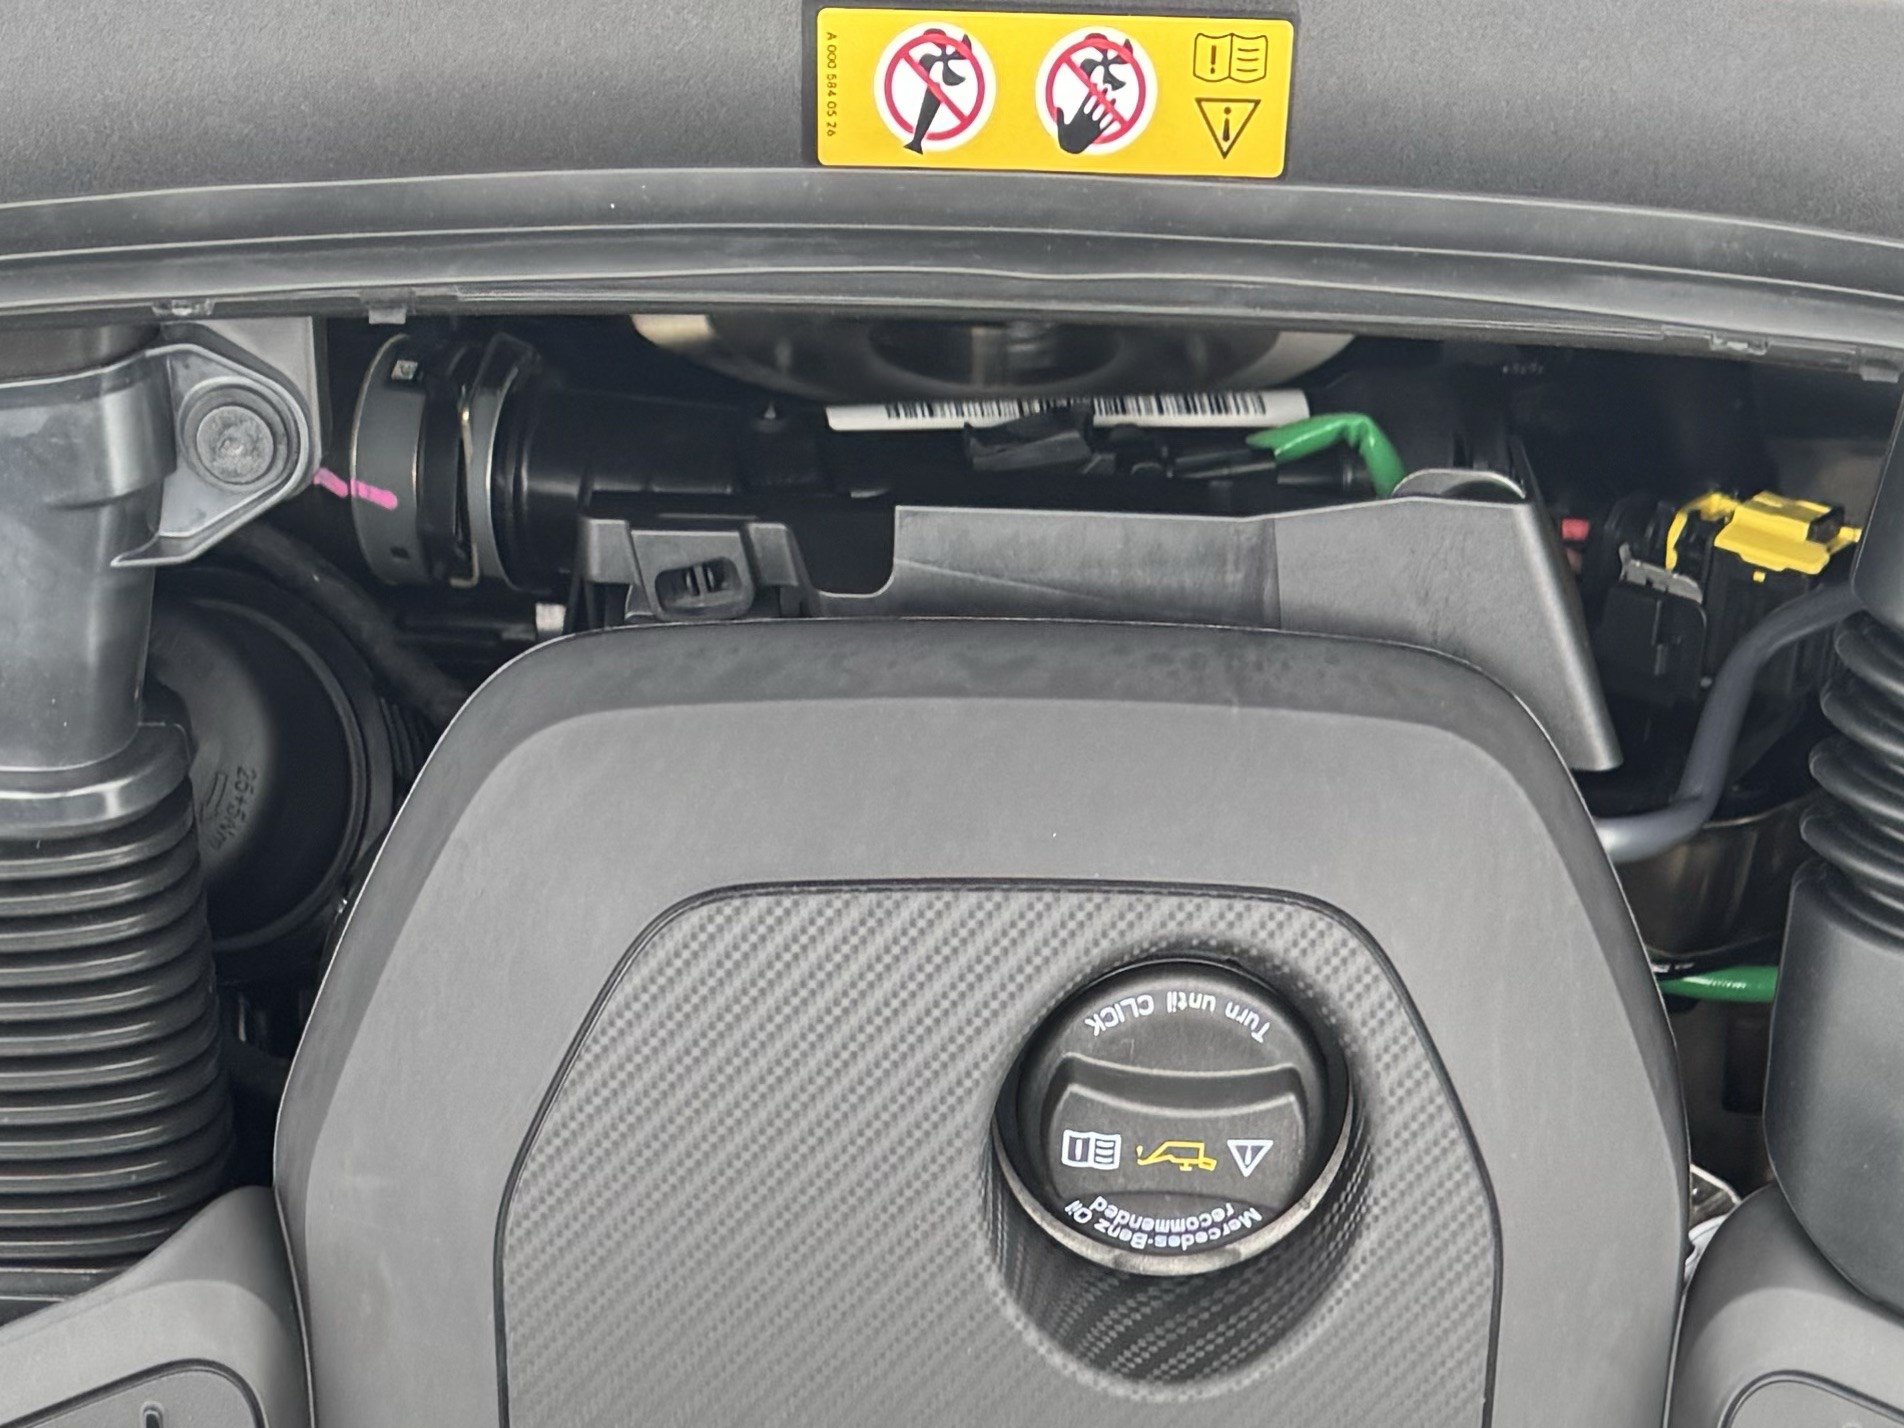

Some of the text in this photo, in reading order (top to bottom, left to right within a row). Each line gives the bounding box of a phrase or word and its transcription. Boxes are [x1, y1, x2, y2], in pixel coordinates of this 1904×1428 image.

[826, 32, 837, 136] A 000 584 05 26
[1085, 992, 1271, 1043] Turn until CLICK
[1064, 1199, 1263, 1251] Mercedes-Benz Oil
[1089, 1196, 1235, 1232] recommended
